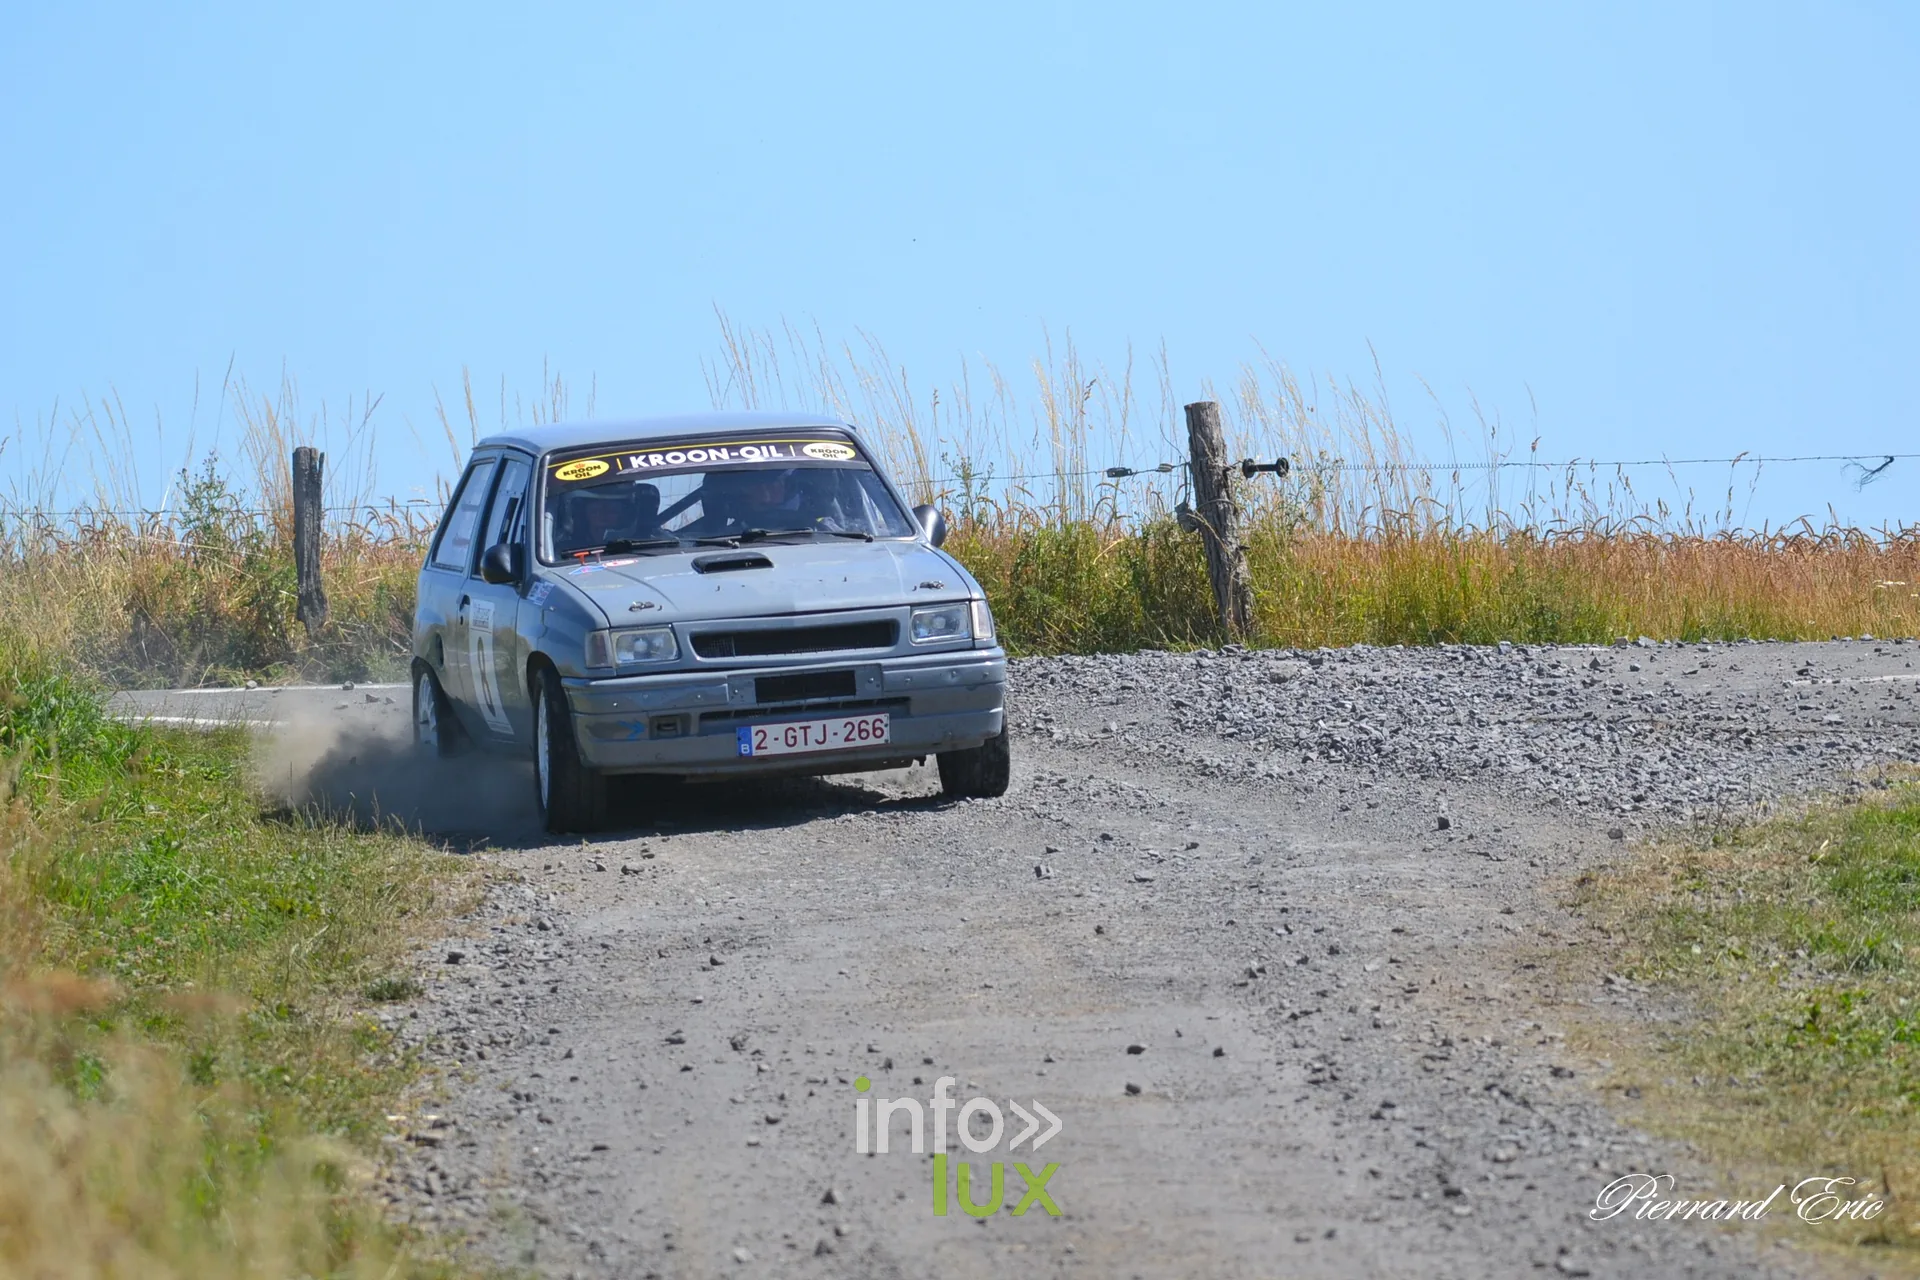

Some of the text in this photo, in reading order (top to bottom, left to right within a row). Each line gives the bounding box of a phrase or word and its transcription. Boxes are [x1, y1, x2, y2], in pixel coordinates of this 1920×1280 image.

[630, 445, 783, 469] KROON-OIL
[563, 464, 601, 476] KROON
[754, 718, 885, 751] 2-GTJ-266
[741, 743, 750, 754] B
